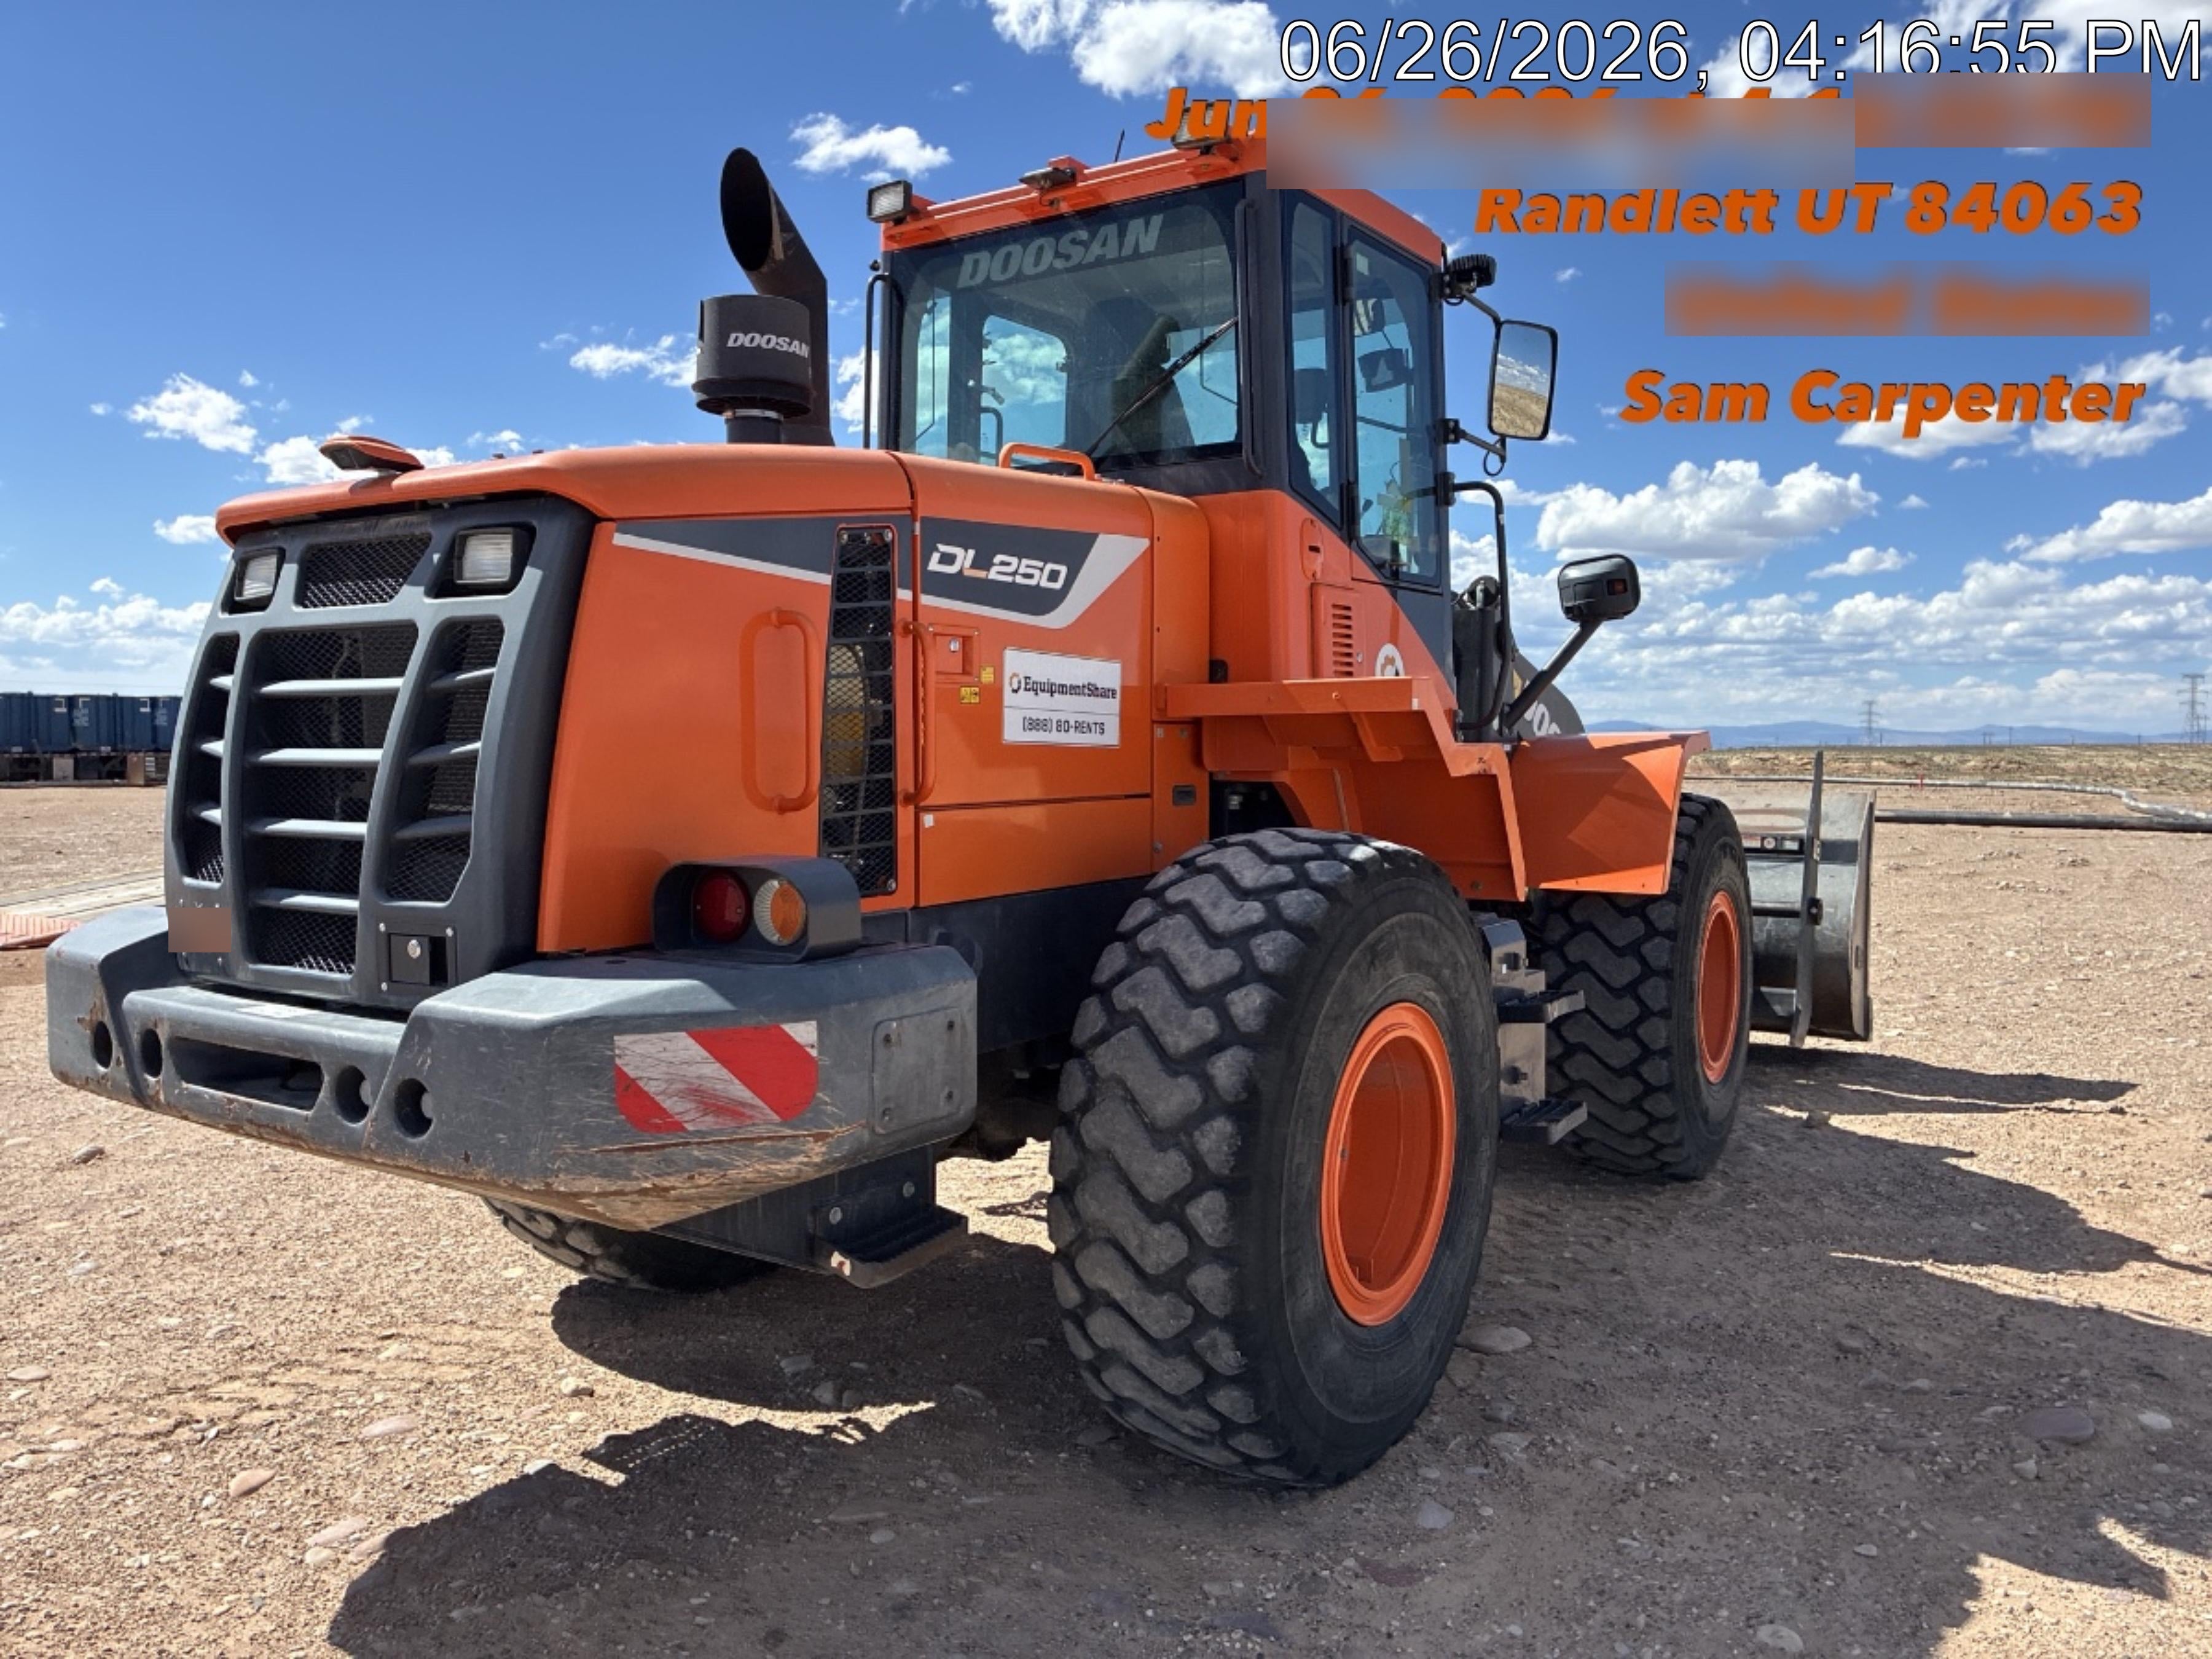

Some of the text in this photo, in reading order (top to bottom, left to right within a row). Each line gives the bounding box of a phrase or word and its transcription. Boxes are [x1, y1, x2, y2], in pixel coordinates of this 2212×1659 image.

[957, 214, 1163, 288] DOOSAN
[726, 333, 810, 358] DOOSAN
[927, 543, 1068, 590] DL250
[1023, 676, 1117, 699] EquipmentShare
